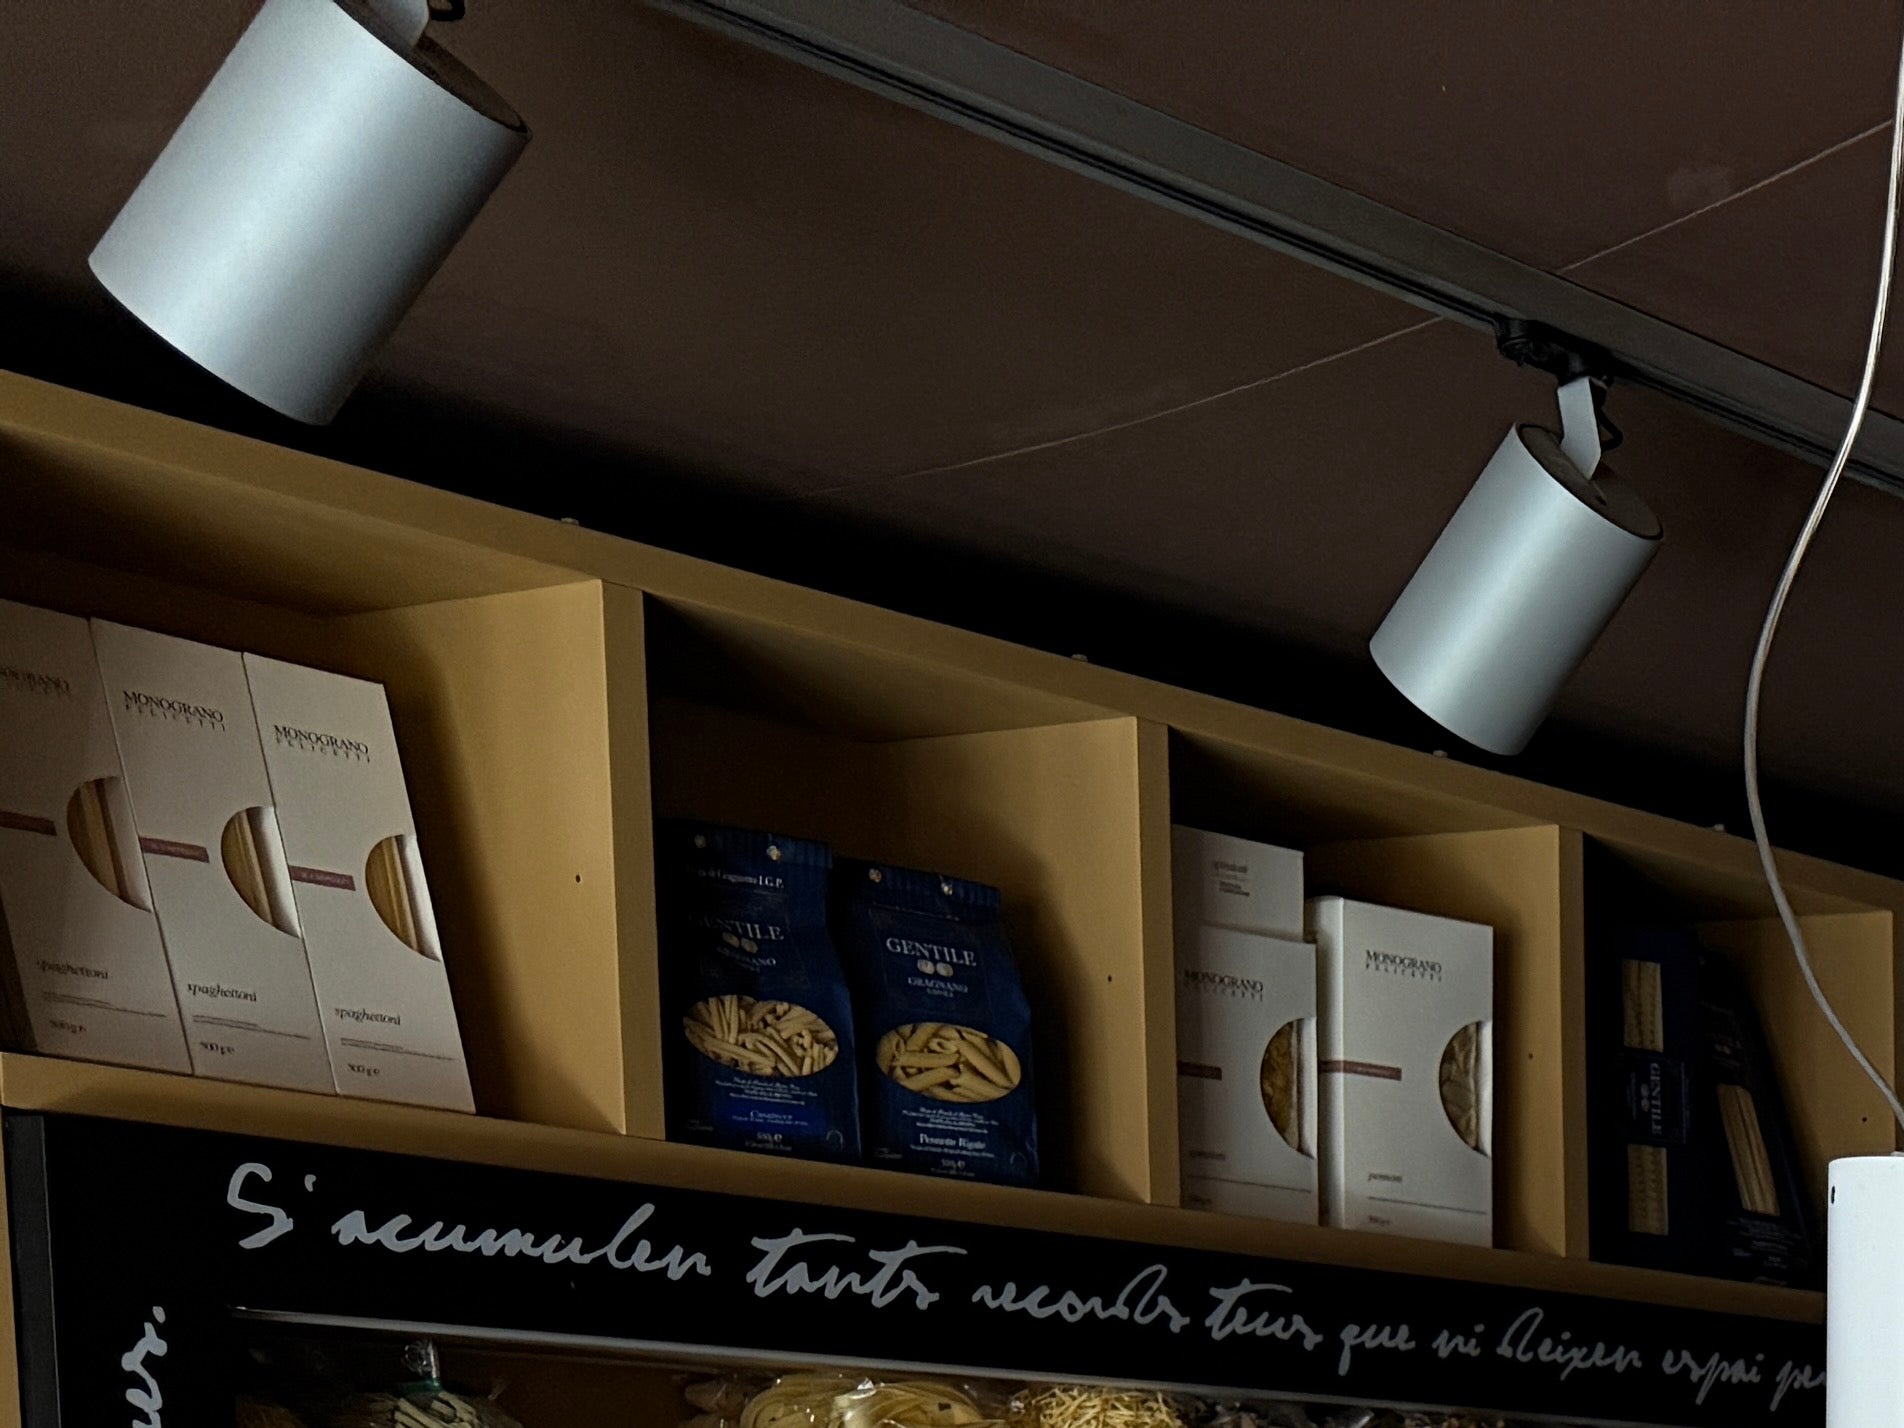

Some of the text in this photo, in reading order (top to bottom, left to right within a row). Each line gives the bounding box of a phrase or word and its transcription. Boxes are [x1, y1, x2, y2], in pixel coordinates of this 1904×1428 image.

[123, 690, 225, 723] MONOGRANO
[274, 725, 369, 755] MONOGRANO
[885, 936, 977, 967] GENTILE
[1366, 948, 1442, 974] MONOGRANO
[187, 981, 257, 1003] spaghettoni
[1184, 968, 1264, 993] MONOGRANO
[335, 1005, 401, 1026] spaghettoni
[226, 1161, 713, 1281] S'acumulen
[747, 1229, 969, 1311] tants
[971, 1262, 1190, 1334] records
[1203, 1279, 1324, 1351] teus
[1339, 1323, 1416, 1376] que
[1494, 1307, 1643, 1381] deixen
[1661, 1348, 1765, 1405] espai
